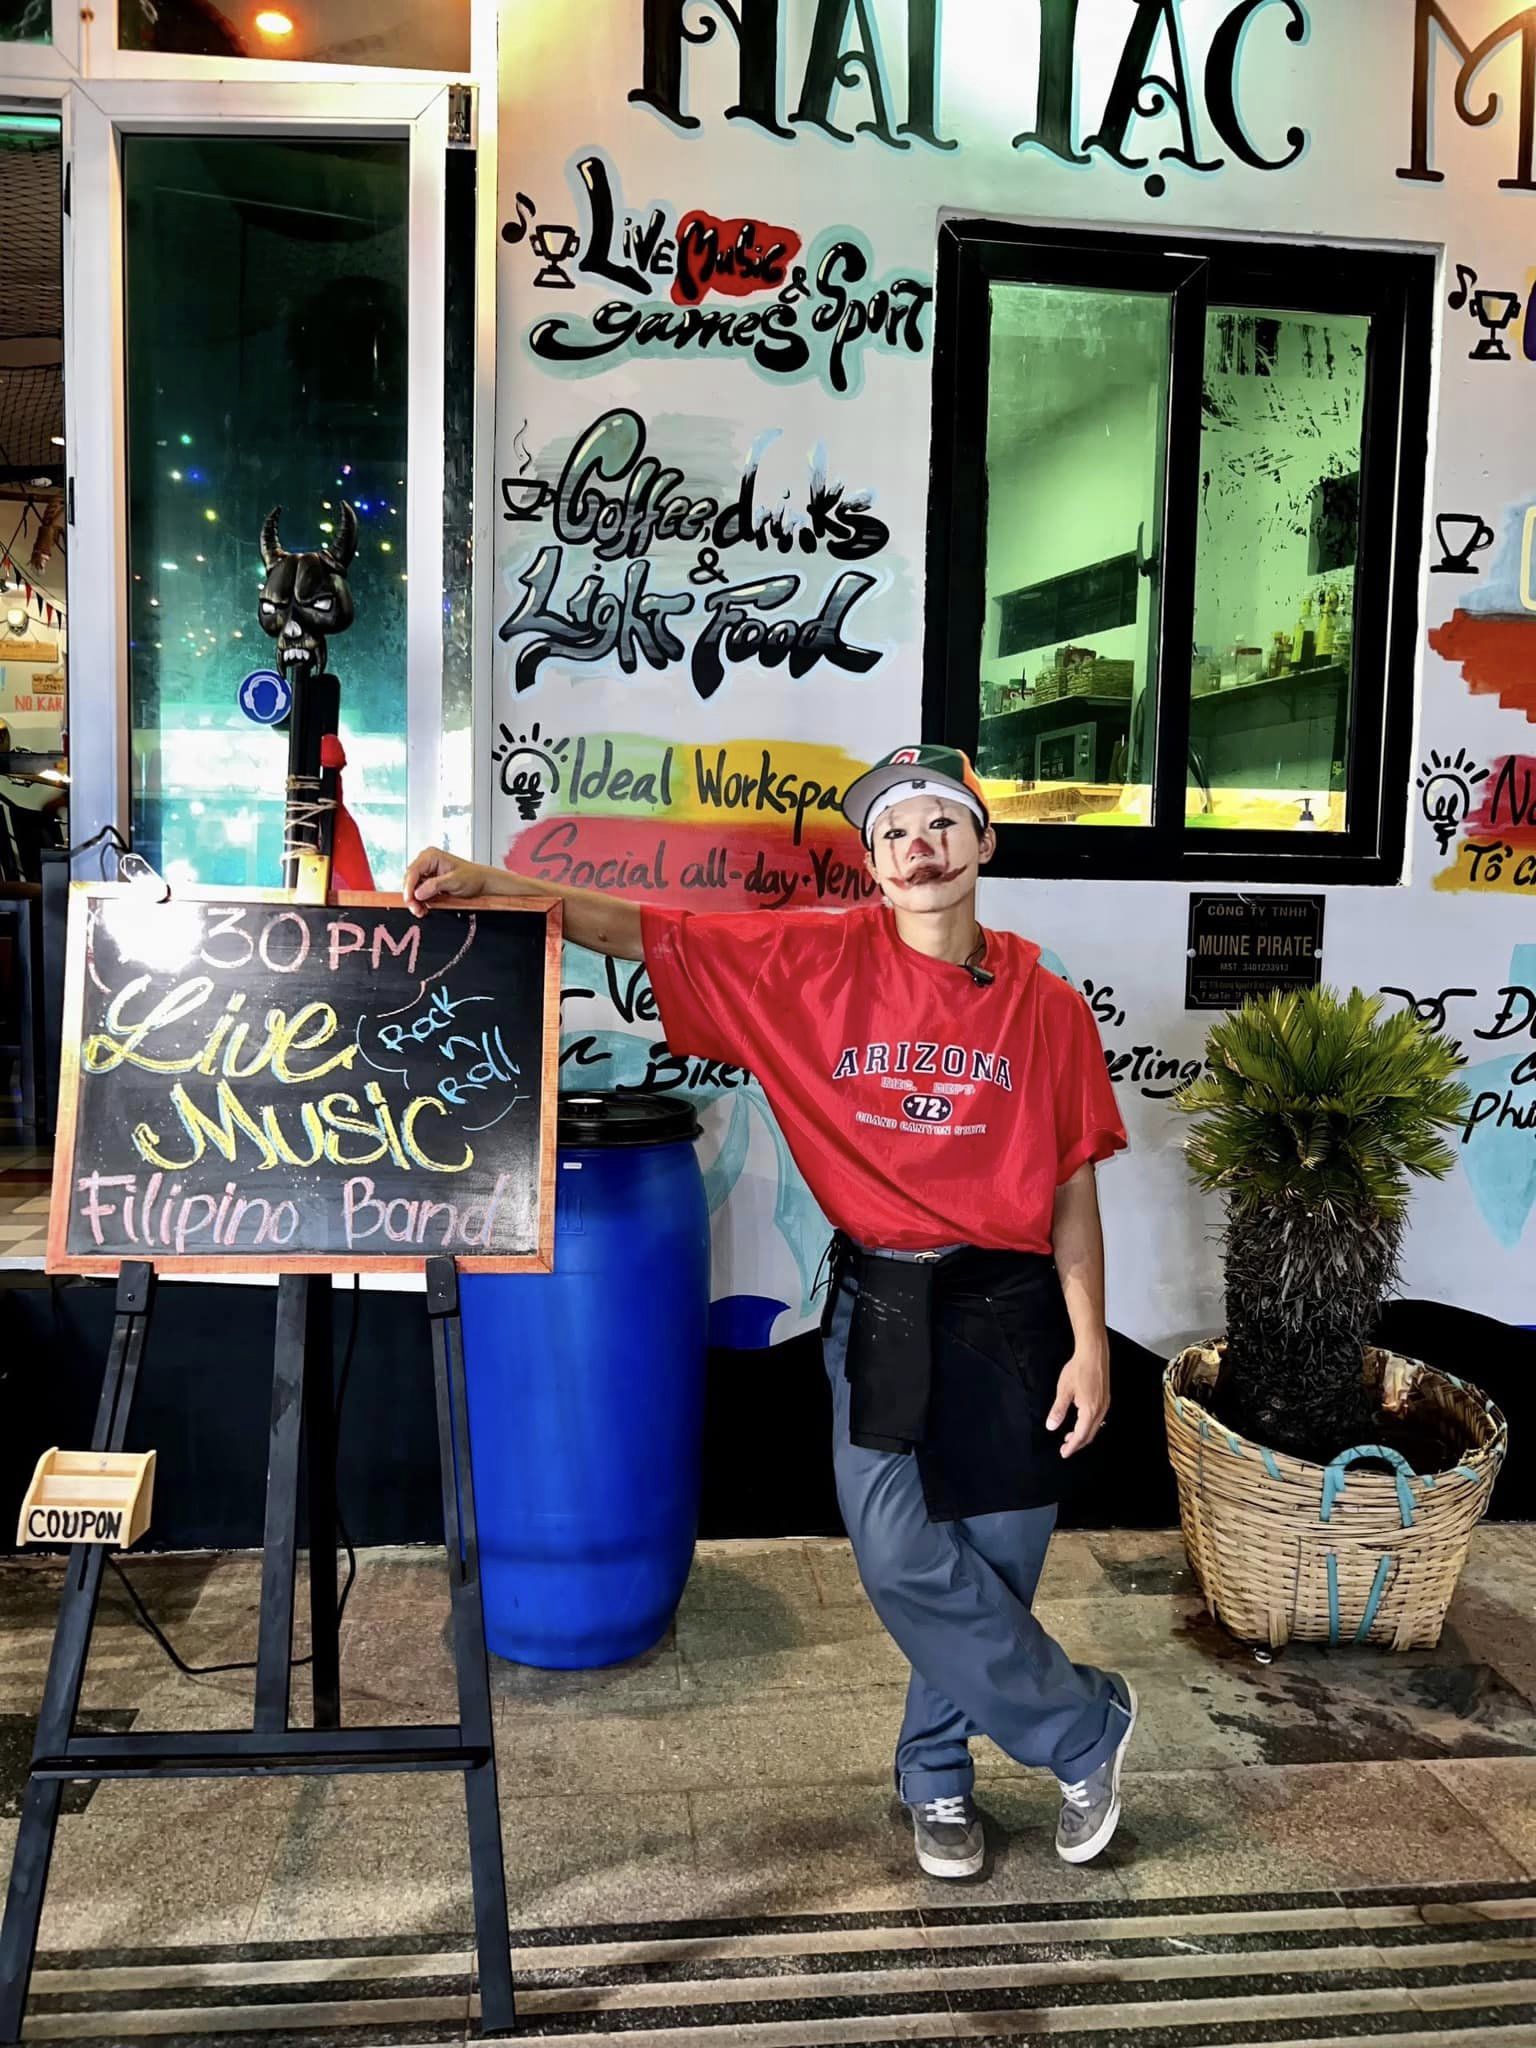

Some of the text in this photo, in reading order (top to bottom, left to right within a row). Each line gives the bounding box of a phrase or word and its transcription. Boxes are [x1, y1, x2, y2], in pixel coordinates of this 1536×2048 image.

[779, 267, 811, 304] &
[689, 547, 729, 584] &
[691, 571, 884, 699] Food
[37, 696, 64, 712] KAR
[570, 736, 845, 846] Ideal Workspa
[530, 822, 670, 890] Social
[1272, 906, 1307, 917] TNHH
[1199, 934, 1313, 957] MUINE PIRATE
[82, 973, 358, 1083] Live
[378, 986, 478, 1054] Rock
[833, 1041, 1012, 1092] ARIZONA
[914, 1096, 941, 1119] 72
[78, 1170, 510, 1255] Filipino Band
[28, 1509, 122, 1539] COUPON
